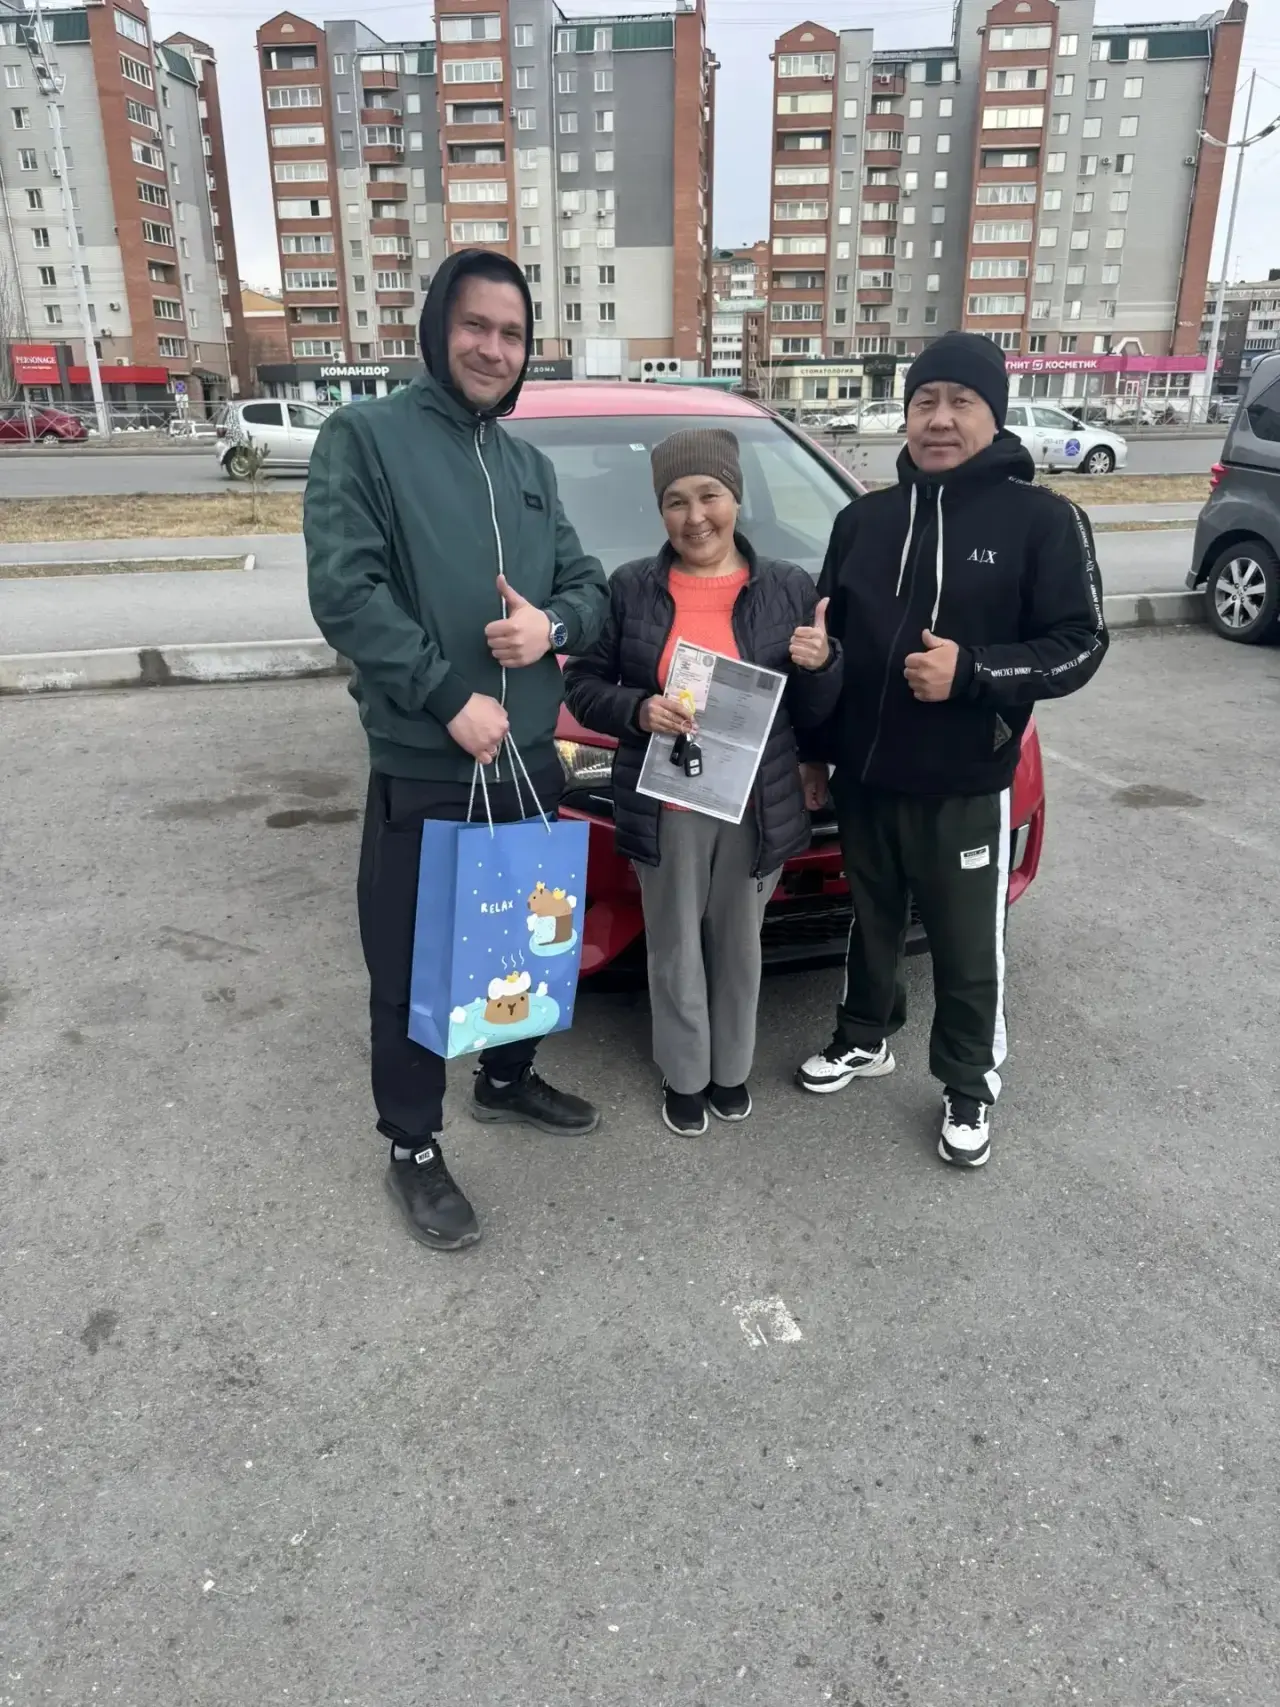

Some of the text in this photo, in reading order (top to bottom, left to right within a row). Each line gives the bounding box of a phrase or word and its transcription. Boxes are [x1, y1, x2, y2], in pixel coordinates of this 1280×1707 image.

[1005, 360, 1097, 369] ГНИТ КОСМЕТИК
[320, 366, 390, 377] КОМАНДОР
[991, 668, 1014, 677] EXCHAN
[1050, 659, 1078, 676] EXCHANGE
[480, 900, 514, 914] RELAX
